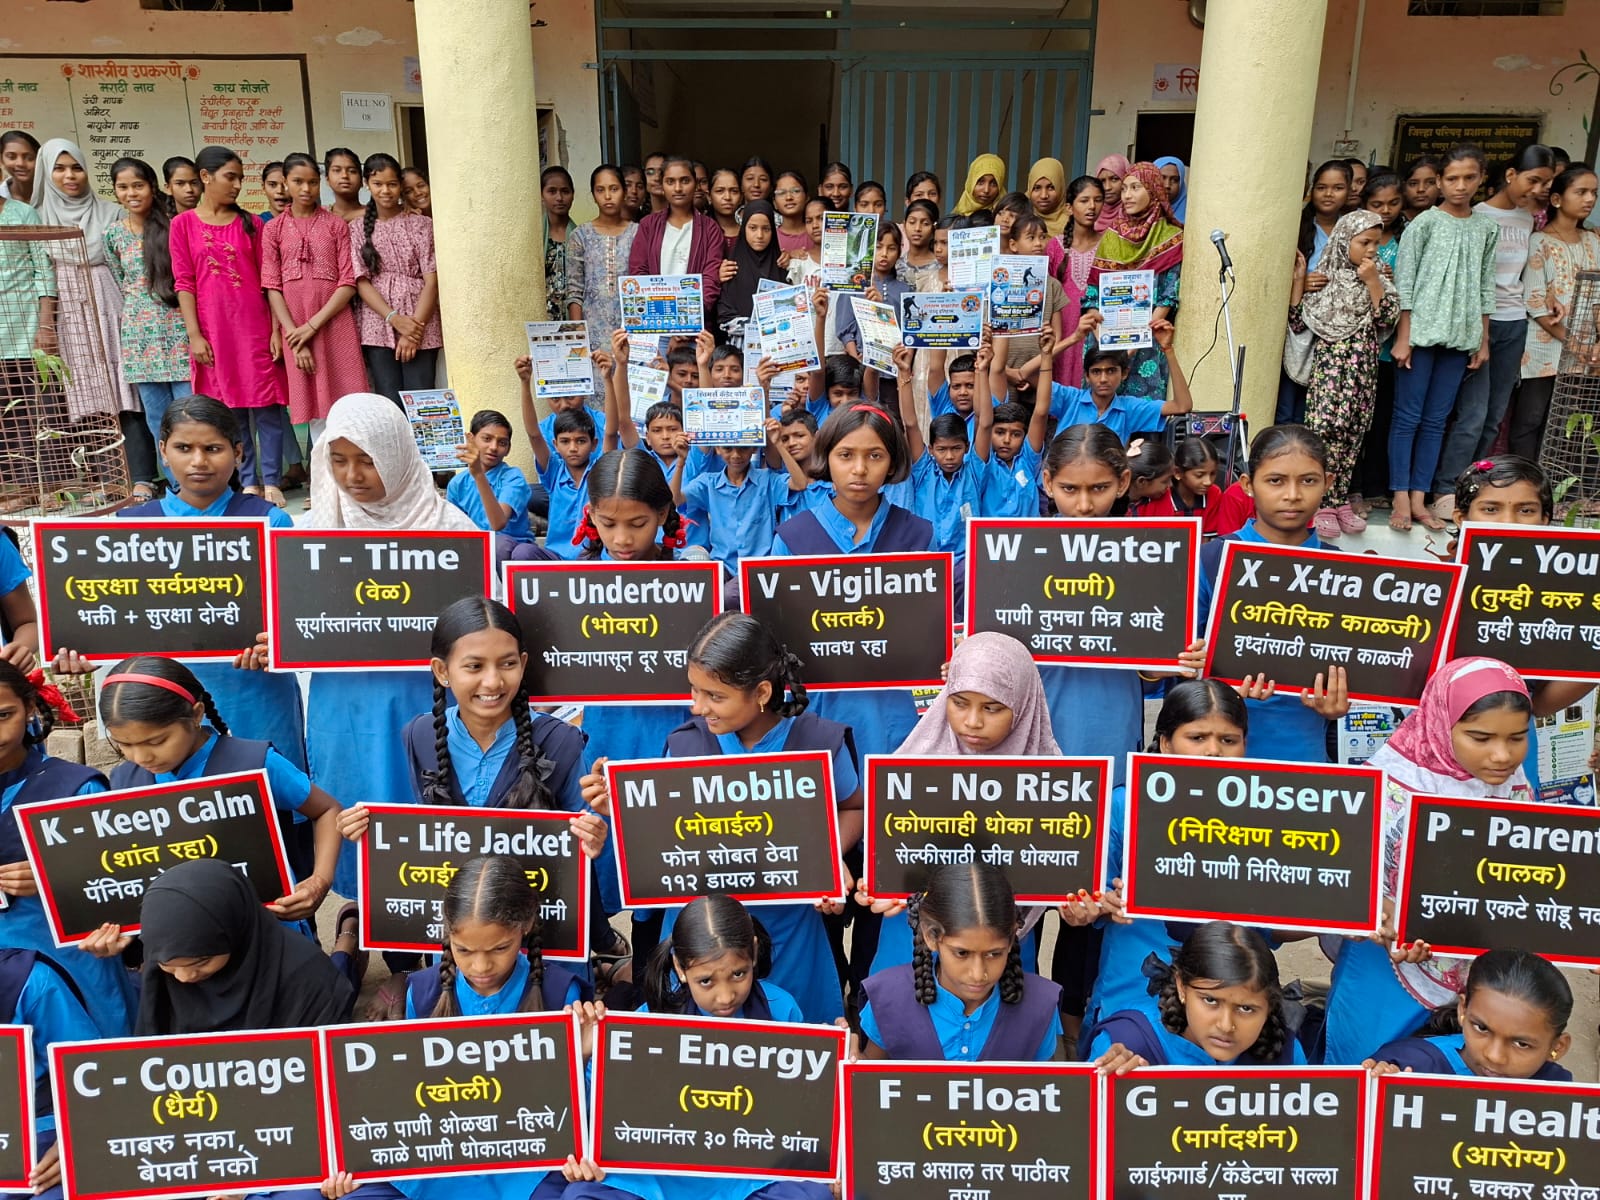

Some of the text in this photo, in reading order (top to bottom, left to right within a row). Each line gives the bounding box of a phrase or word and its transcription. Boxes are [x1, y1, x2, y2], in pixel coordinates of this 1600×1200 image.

[78, 61, 182, 80] शास्त्रीय उपकरणे
[98, 79, 128, 93] मराठी
[213, 83, 236, 93] काय
[51, 533, 251, 569] S Safety First
[303, 542, 459, 570] T Time
[985, 534, 1180, 563] W Water
[1478, 543, 1599, 575] Y You
[66, 573, 243, 601] (सुरक्षा सर्वप्रथम)
[356, 578, 410, 604] (वेळ)
[521, 575, 705, 605] U Undertow
[758, 567, 936, 602] V Vigilant
[1044, 573, 1114, 600] (पाणी)
[1237, 559, 1441, 606] X X-tra Care
[1471, 584, 1533, 612] (तुम्ही
[1541, 592, 1584, 609] करु
[145, 608, 192, 629] सुरक्षा
[198, 602, 240, 625] दोन्ही
[295, 612, 382, 639] सूर्यास्तानंतर
[582, 612, 658, 638] (भोवरा)
[812, 606, 884, 631] (सतर्क)
[995, 603, 1164, 631] पाणी तुमचा मित्र आहे
[1231, 600, 1430, 643] (अतिरिक्त काळजी)
[1031, 634, 1116, 652] आदर करा.
[1478, 616, 1514, 643] तुम्ही
[1519, 618, 1574, 645] सुरक्षित
[638, 651, 658, 673] दूर
[663, 650, 688, 668] रहा
[810, 640, 887, 657] सावध रहा
[1310, 643, 1353, 662] जास्त
[1357, 647, 1413, 668] काळजी
[624, 769, 816, 807] M Mobile
[888, 772, 1092, 801] N No Risk
[1147, 772, 1365, 814] O Observ
[40, 791, 255, 845] K Keep Calm
[675, 811, 773, 840] (मोबाईल)
[885, 810, 1091, 838] (कोणताही धोका नाही)
[1428, 812, 1450, 841] P
[376, 822, 571, 857] L Life Jacket
[1168, 817, 1340, 855] (निरिक्षण करा)
[101, 835, 217, 872] (शांत रहा)
[661, 841, 798, 867] फोन सोबत ठेवा
[895, 842, 1079, 866] सेल्फीसाठी जीव धोक्यात
[399, 862, 458, 887] (लाई
[661, 870, 798, 891] ११२ डायल करा
[1155, 852, 1351, 887] आधी पाणी निरिक्षण करा
[1477, 858, 1565, 889] (पालक)
[83, 878, 143, 903] पॅनिक
[385, 898, 426, 917] लहान
[1421, 891, 1572, 930] मुलांना एकटे सोडू
[345, 1029, 555, 1072] D Depth
[610, 1031, 831, 1080] E Energy
[73, 1057, 305, 1097] C Courage
[416, 1075, 501, 1107] (खोली)
[153, 1088, 217, 1124] (धैर्य)
[680, 1085, 753, 1115] (उर्जा)
[880, 1079, 1060, 1112] F Float
[1126, 1083, 1339, 1116] G Guide
[349, 1117, 388, 1140] खोल
[393, 1113, 432, 1137] पाणी
[440, 1111, 498, 1134] ओळखा
[1393, 1094, 1423, 1128] H
[107, 1127, 293, 1156] घाबरु नका, पण
[371, 1135, 546, 1165] काळे पाणी धोकादायक
[614, 1121, 819, 1152] जेवणानंतर ३० मिनटे थांबा
[923, 1120, 1017, 1151] (तरंगणे)
[1172, 1124, 1297, 1152] (मार्गदर्शन)
[137, 1150, 258, 1182] बेपर्वा नको
[877, 1158, 1070, 1184] बुडत असाल तर पाठीवर
[1453, 1141, 1565, 1174] (आरोग्य)
[1290, 1168, 1338, 1185] सल्ला
[1413, 1176, 1458, 1199] ताप,
[1469, 1180, 1534, 1200] चक्कर
